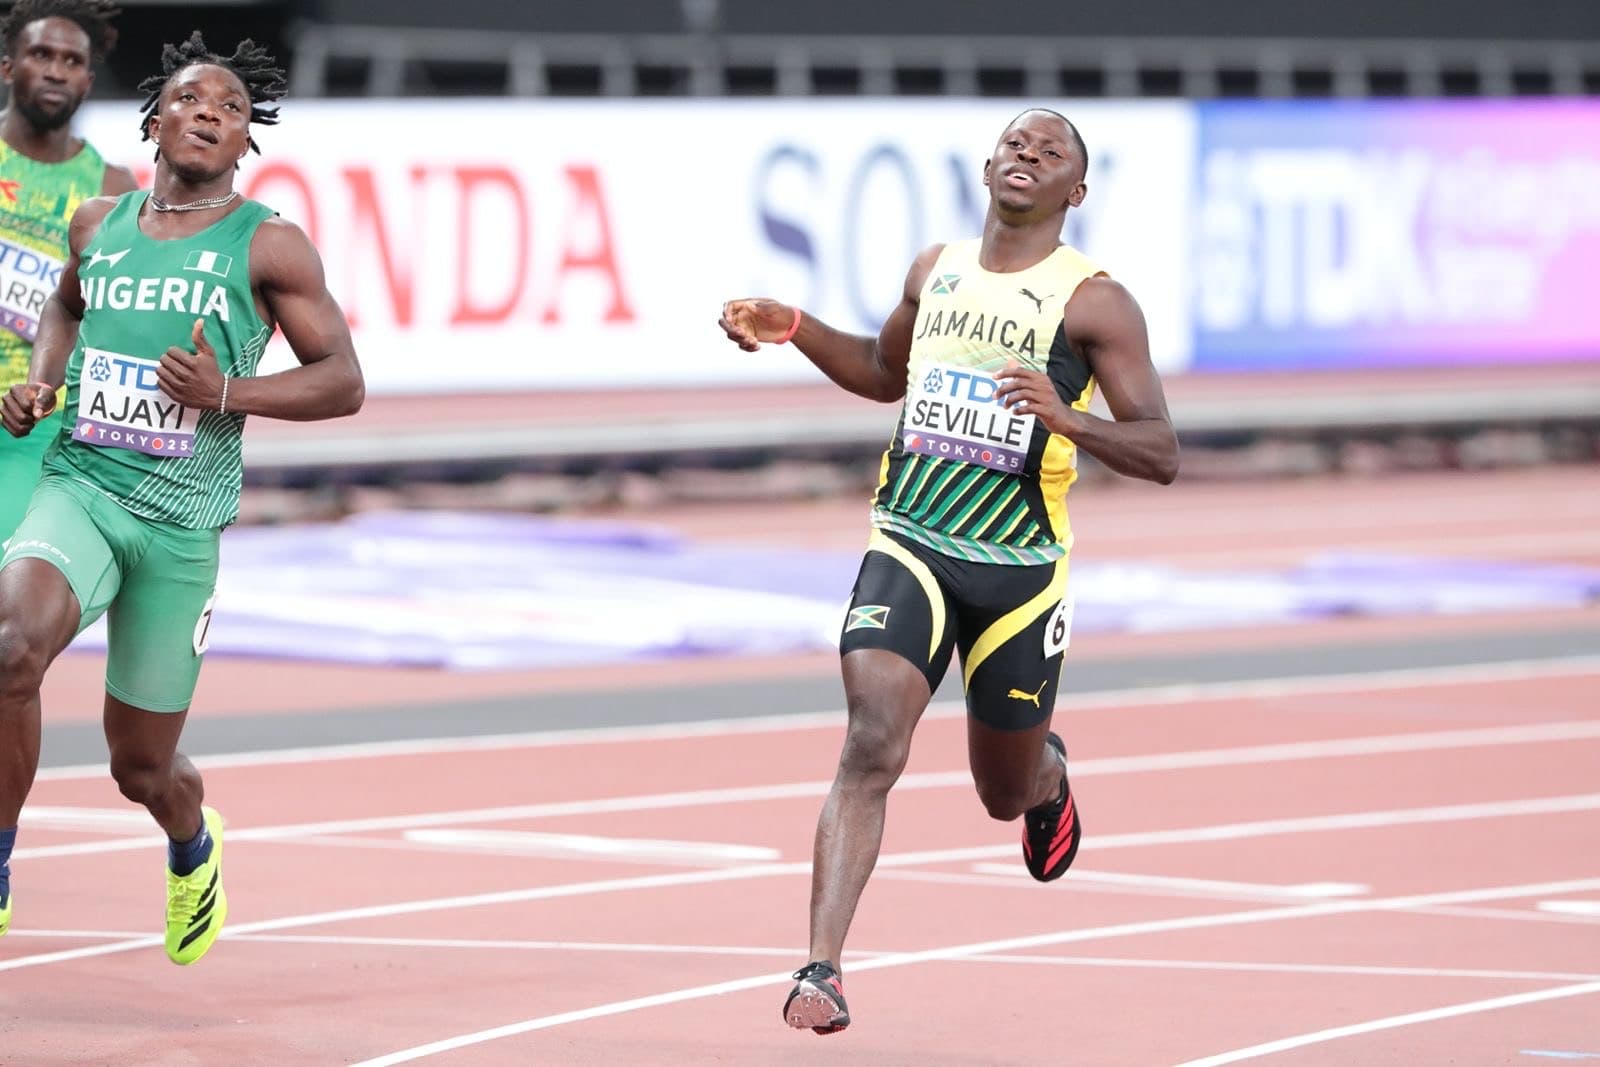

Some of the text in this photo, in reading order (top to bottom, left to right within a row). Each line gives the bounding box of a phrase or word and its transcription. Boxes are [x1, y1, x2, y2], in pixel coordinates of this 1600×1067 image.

[140, 158, 640, 335] ONDA
[750, 140, 1120, 332] SO
[80, 276, 231, 322] NIGERIA
[917, 310, 1036, 359] JAMAICA
[112, 358, 161, 391] TD
[89, 390, 185, 430] AJAYI
[911, 399, 1026, 447] SEVILLE
[1052, 605, 1066, 646] 6
